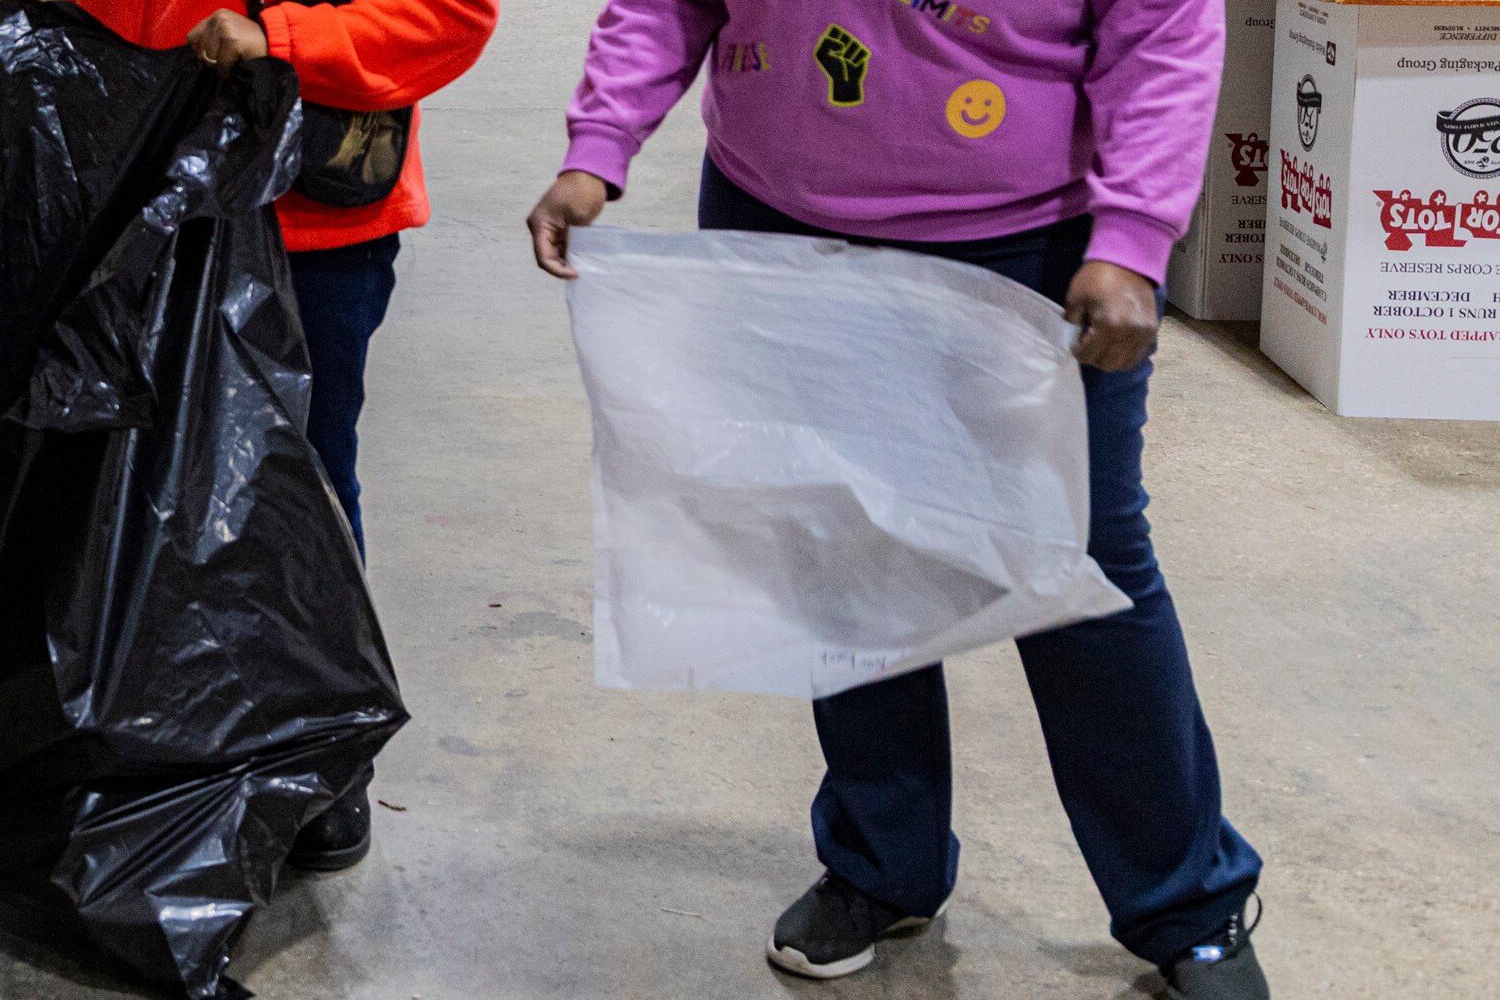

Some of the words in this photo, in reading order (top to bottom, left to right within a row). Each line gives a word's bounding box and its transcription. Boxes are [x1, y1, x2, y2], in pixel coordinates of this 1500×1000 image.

[1439, 32, 1497, 41] DIFFERENCE
[1397, 57, 1437, 71] Group
[1238, 144, 1269, 167] TS
[1389, 203, 1452, 231] TOTS
[1465, 207, 1500, 235] OR
[1218, 254, 1253, 264] ONLY
[1380, 261, 1443, 274] RESERVE
[1447, 263, 1493, 275] CORPS
[1387, 289, 1471, 303] DECEMBER
[1372, 305, 1445, 319] OCTOBER
[1458, 307, 1497, 319] RUNS
[1365, 327, 1406, 340] ONLY
[1408, 328, 1447, 341] TOYS
[1450, 329, 1500, 342] APPED
